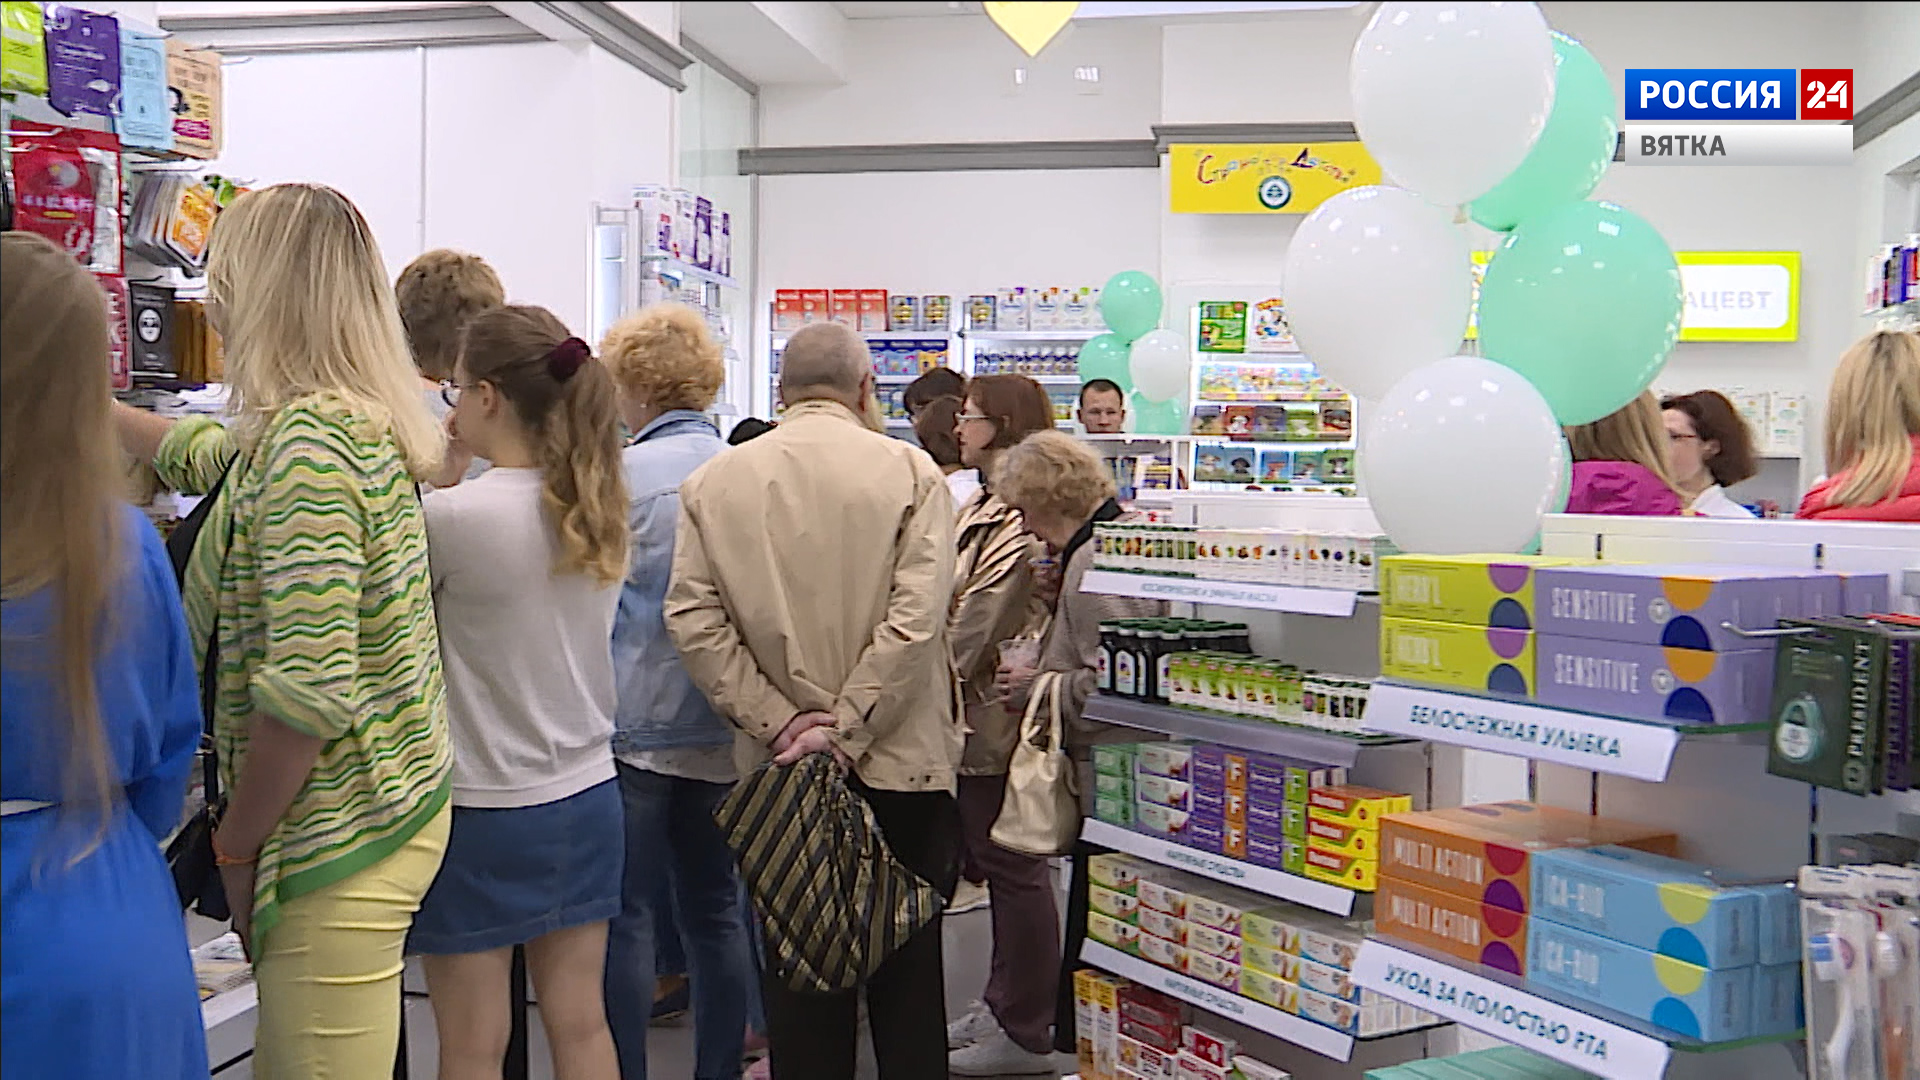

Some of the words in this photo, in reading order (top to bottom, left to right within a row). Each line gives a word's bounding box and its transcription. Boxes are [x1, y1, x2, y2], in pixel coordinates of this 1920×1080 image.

[1552, 587, 1637, 624] SENSITIVE
[1554, 653, 1640, 694] SENSITIVE
[1410, 705, 1537, 742] БЕЛОСНЕЖНАЯ
[1540, 727, 1621, 758] УЛЫБКА
[1435, 847, 1484, 885] ACTION
[1432, 907, 1481, 946] ACTION
[1384, 963, 1432, 998] УХОД
[1435, 980, 1457, 1006] ЗА
[1461, 990, 1571, 1044] ПОЛОСТЬЮ
[1573, 1029, 1609, 1060] РТА
